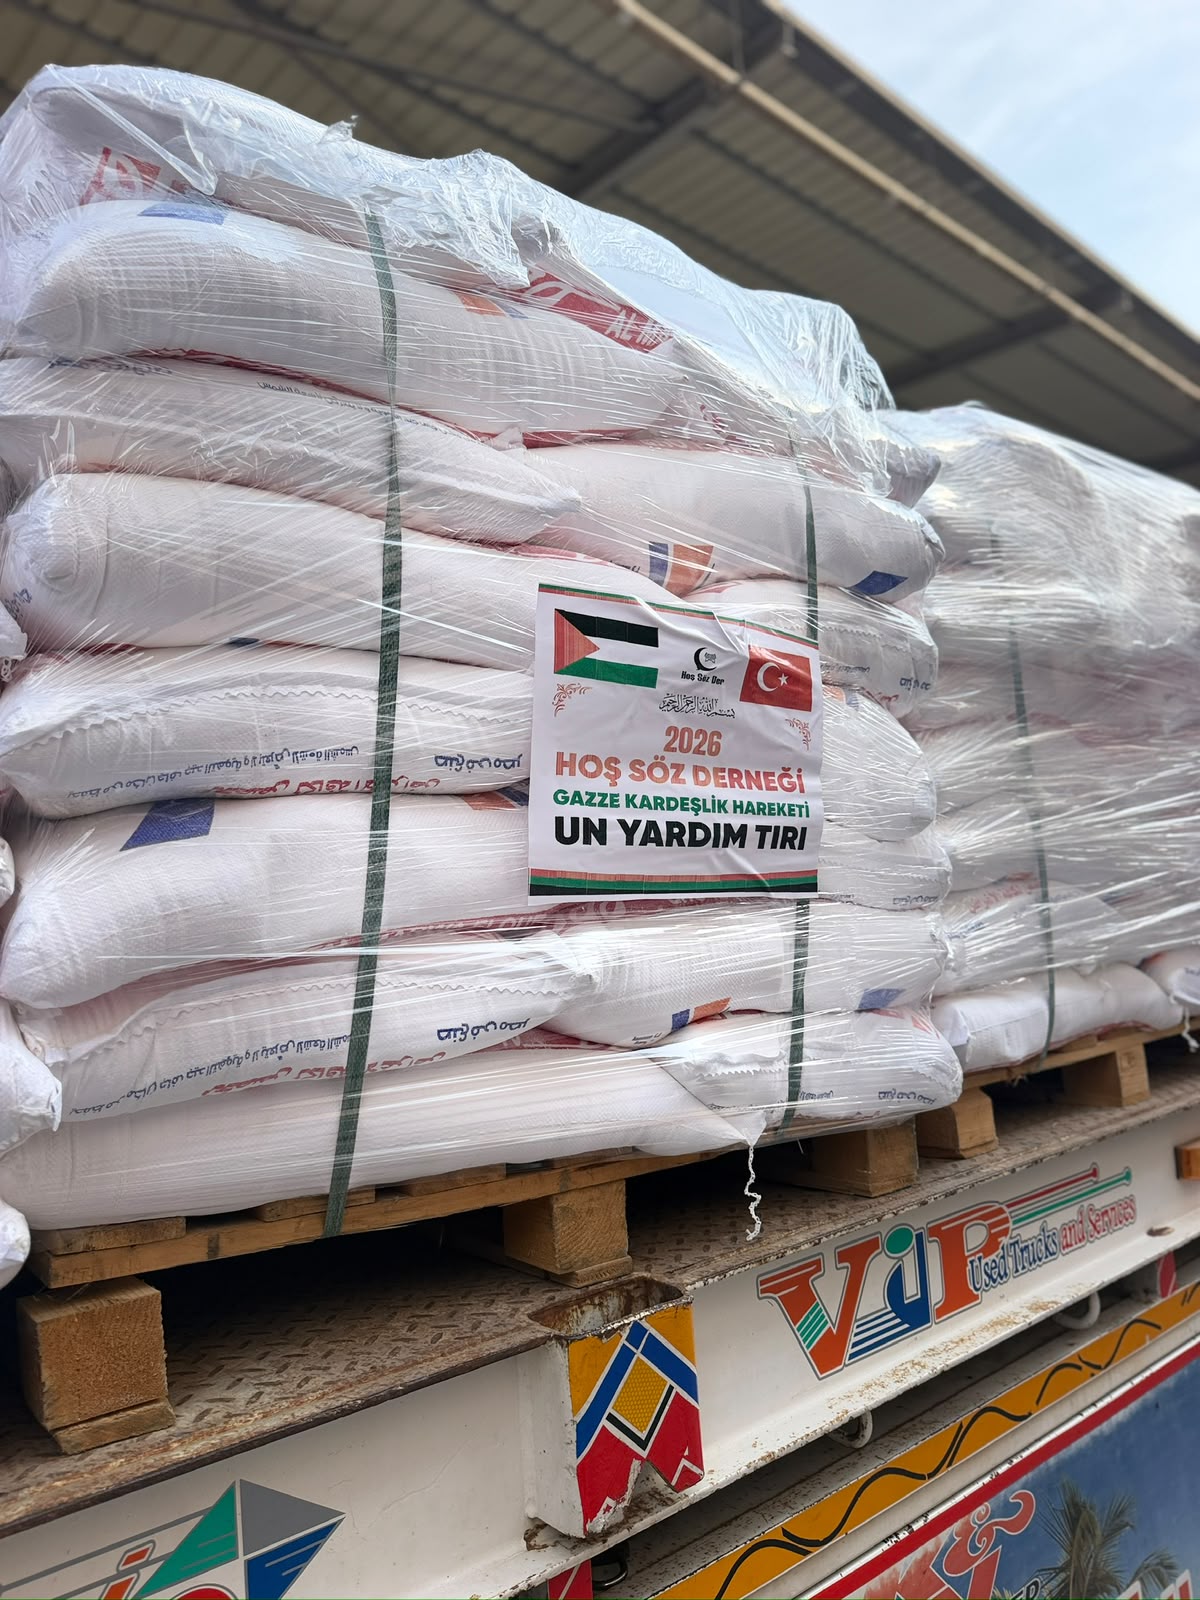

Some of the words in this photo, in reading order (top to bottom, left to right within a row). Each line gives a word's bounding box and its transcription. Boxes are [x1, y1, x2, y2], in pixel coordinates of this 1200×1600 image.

[681, 671, 695, 681] Hoş
[697, 673, 710, 682] Söz
[711, 676, 725, 685] Der
[664, 725, 722, 757] 2026
[434, 754, 465, 773] صنع
[494, 754, 524, 771] مصر
[555, 751, 622, 788] HOŞ
[628, 755, 686, 784] SÖZ
[692, 763, 806, 794] DERNEĞİ
[553, 788, 620, 809] GAZZE
[625, 793, 729, 817] KARDEŞLİK
[732, 800, 811, 819] HAREKETİ
[554, 816, 608, 846] UN
[616, 817, 748, 849] YARDIM
[754, 825, 808, 851] TIRI
[437, 1023, 469, 1044] صنع
[498, 1017, 530, 1032] مصر
[969, 1234, 1010, 1292] Used
[1008, 1221, 1059, 1277] Trucks
[1060, 1214, 1086, 1254] and
[1086, 1195, 1136, 1244] Services
